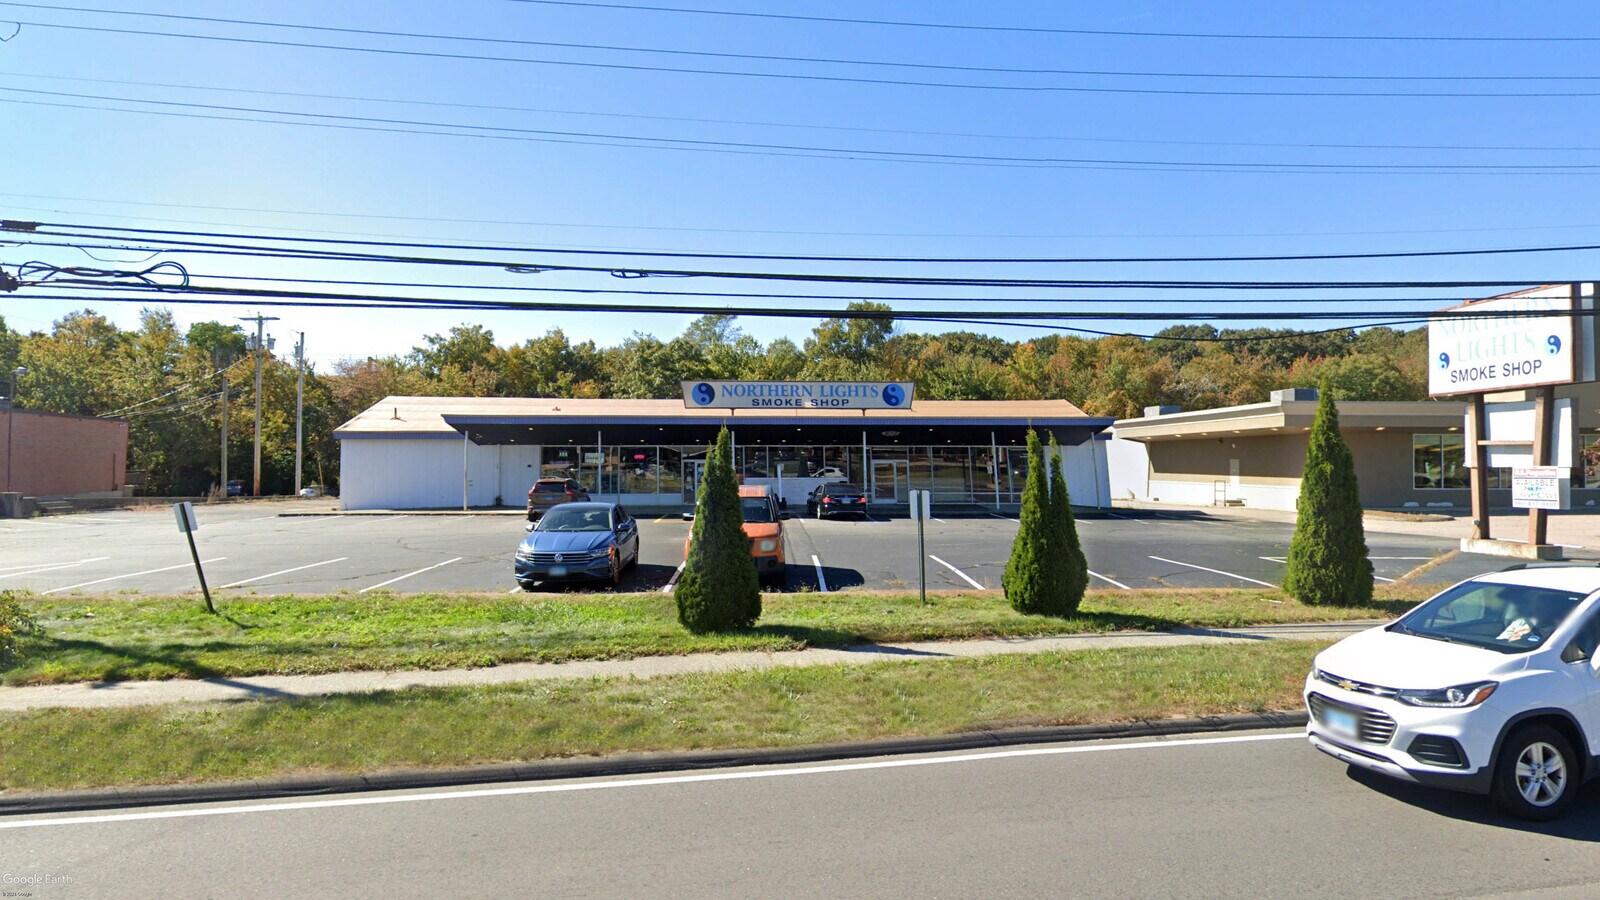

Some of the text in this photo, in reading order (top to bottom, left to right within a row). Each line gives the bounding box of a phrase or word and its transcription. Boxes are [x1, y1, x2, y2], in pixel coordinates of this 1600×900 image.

[1456, 331, 1536, 361] LIGHTS
[1450, 359, 1543, 384] SMOKE SHOP
[721, 384, 879, 398] NORTHERN LIGHTS
[752, 398, 850, 407] SMOKE SHOP
